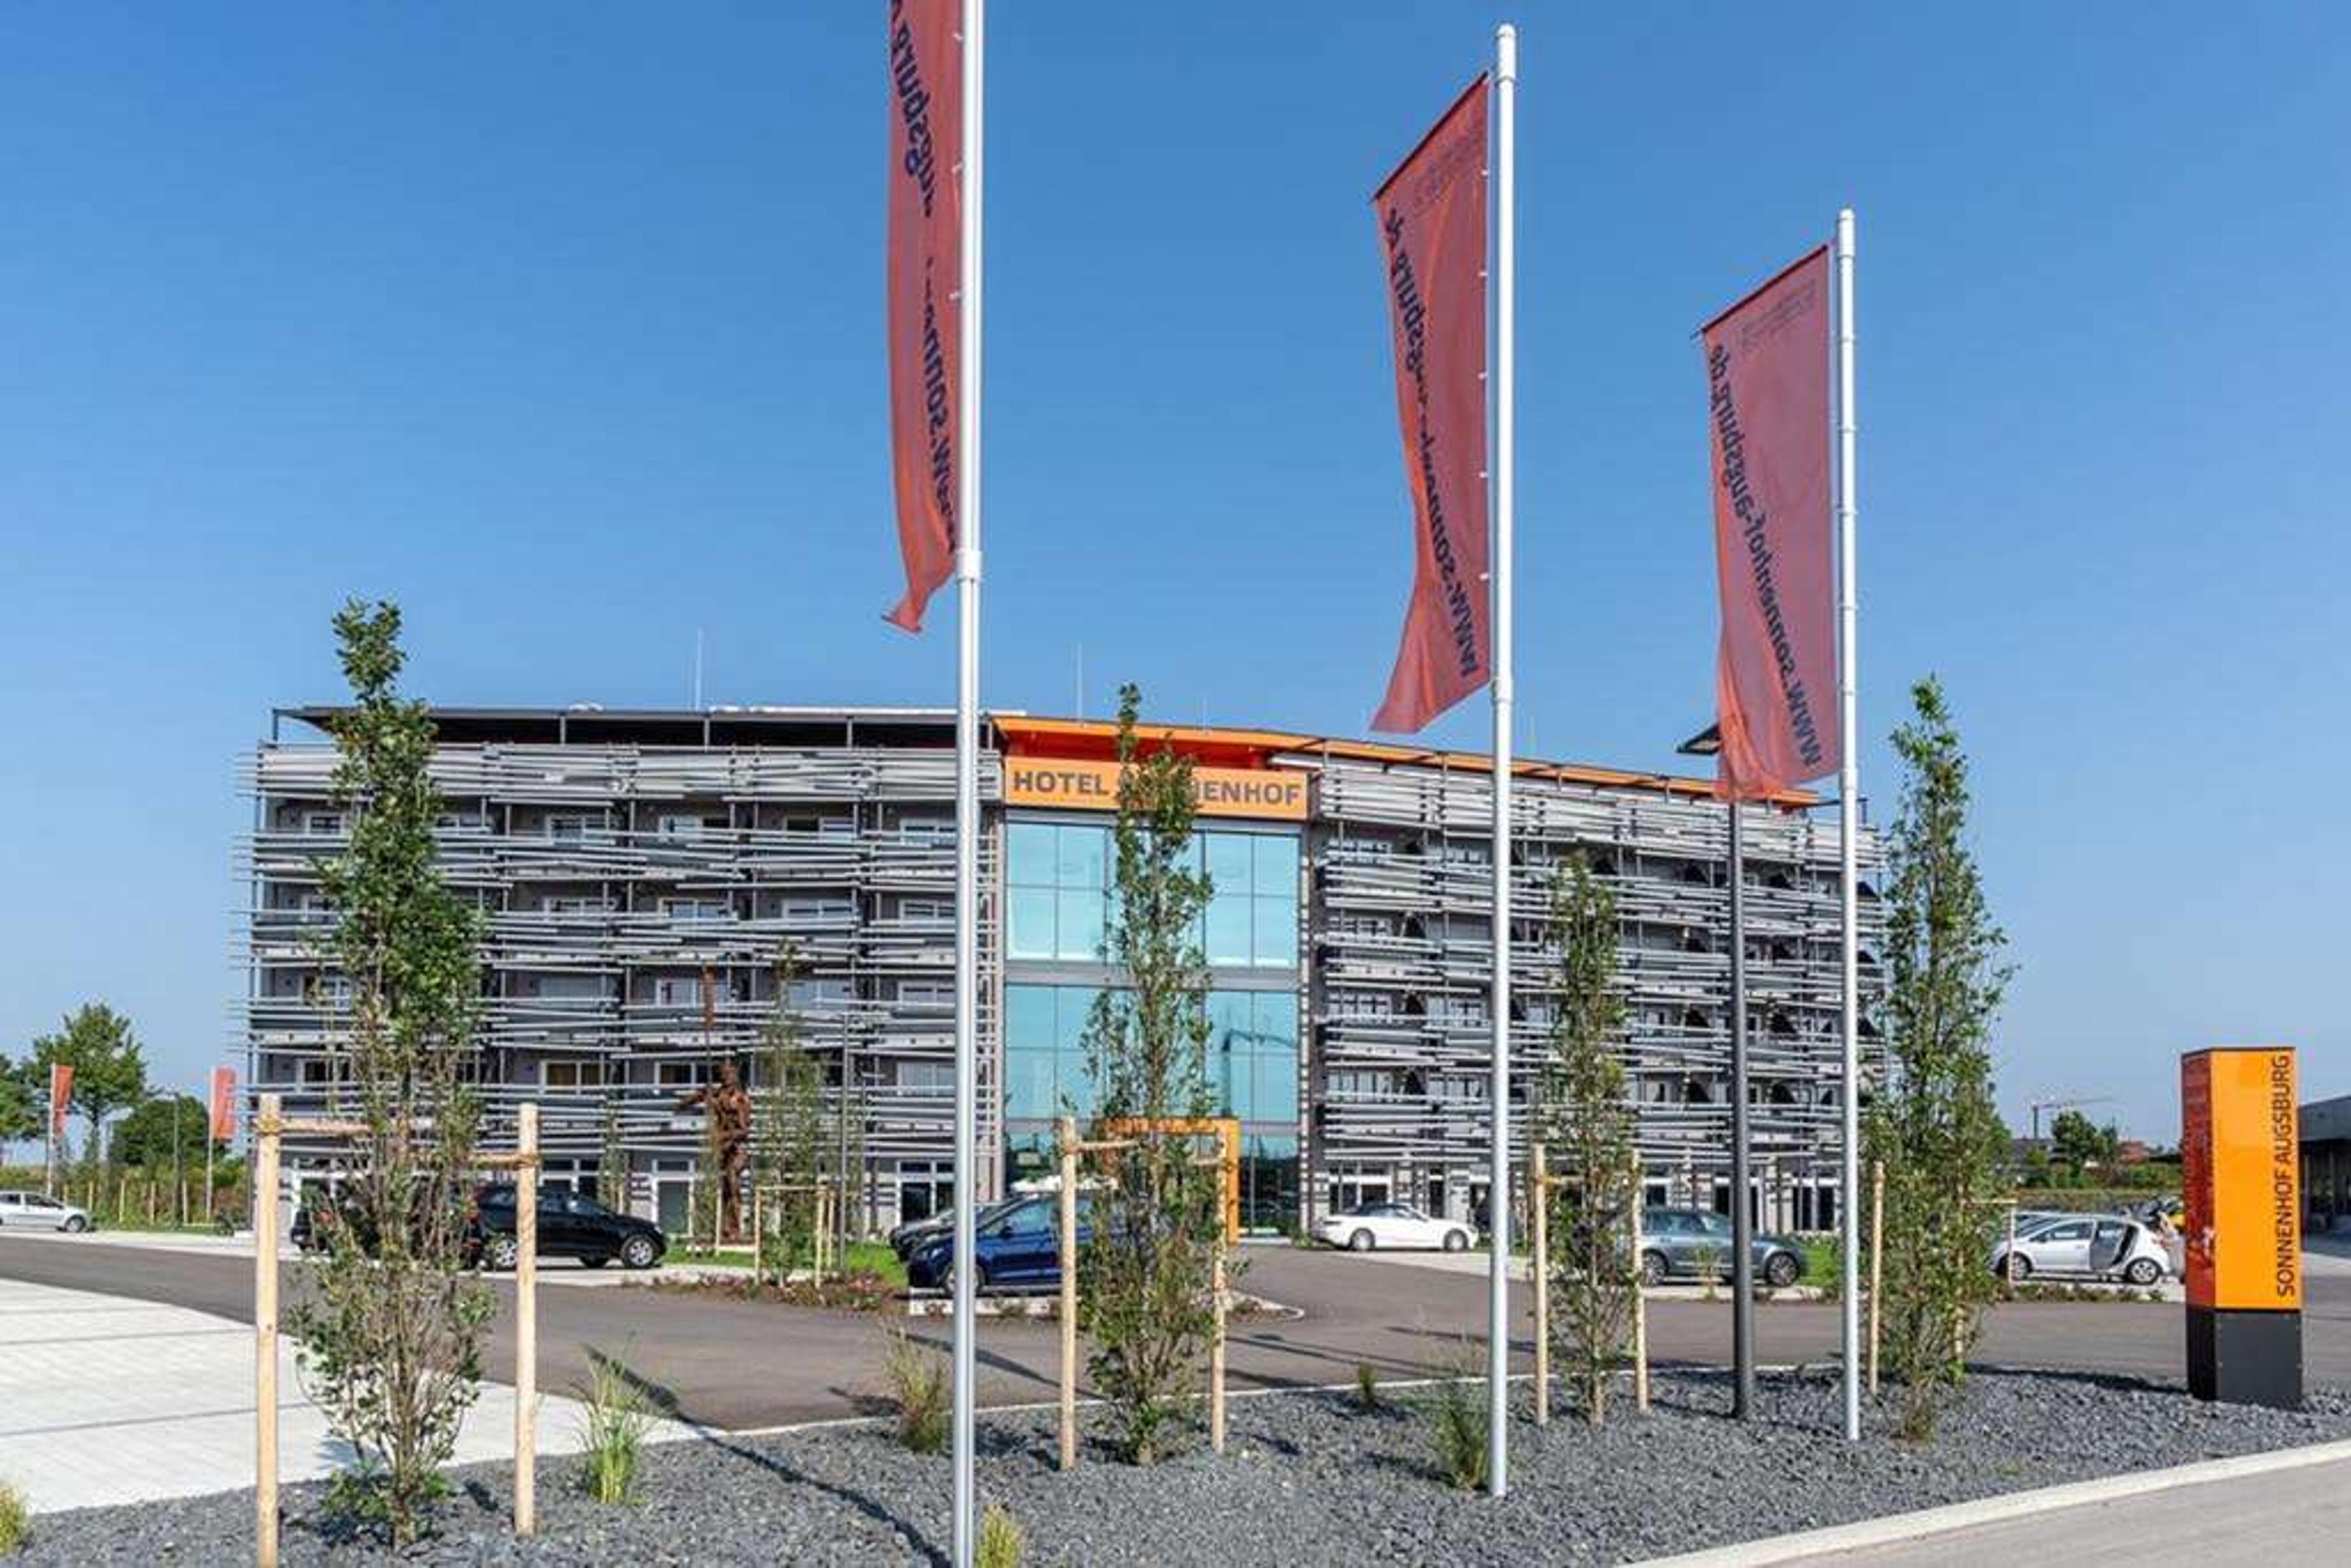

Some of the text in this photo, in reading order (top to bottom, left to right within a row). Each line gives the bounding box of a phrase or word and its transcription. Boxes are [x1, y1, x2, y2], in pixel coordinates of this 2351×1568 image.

[1013, 770, 1110, 795] HOTEL
[2272, 1055, 2295, 1298] SONNENHOF AUGSBURG
